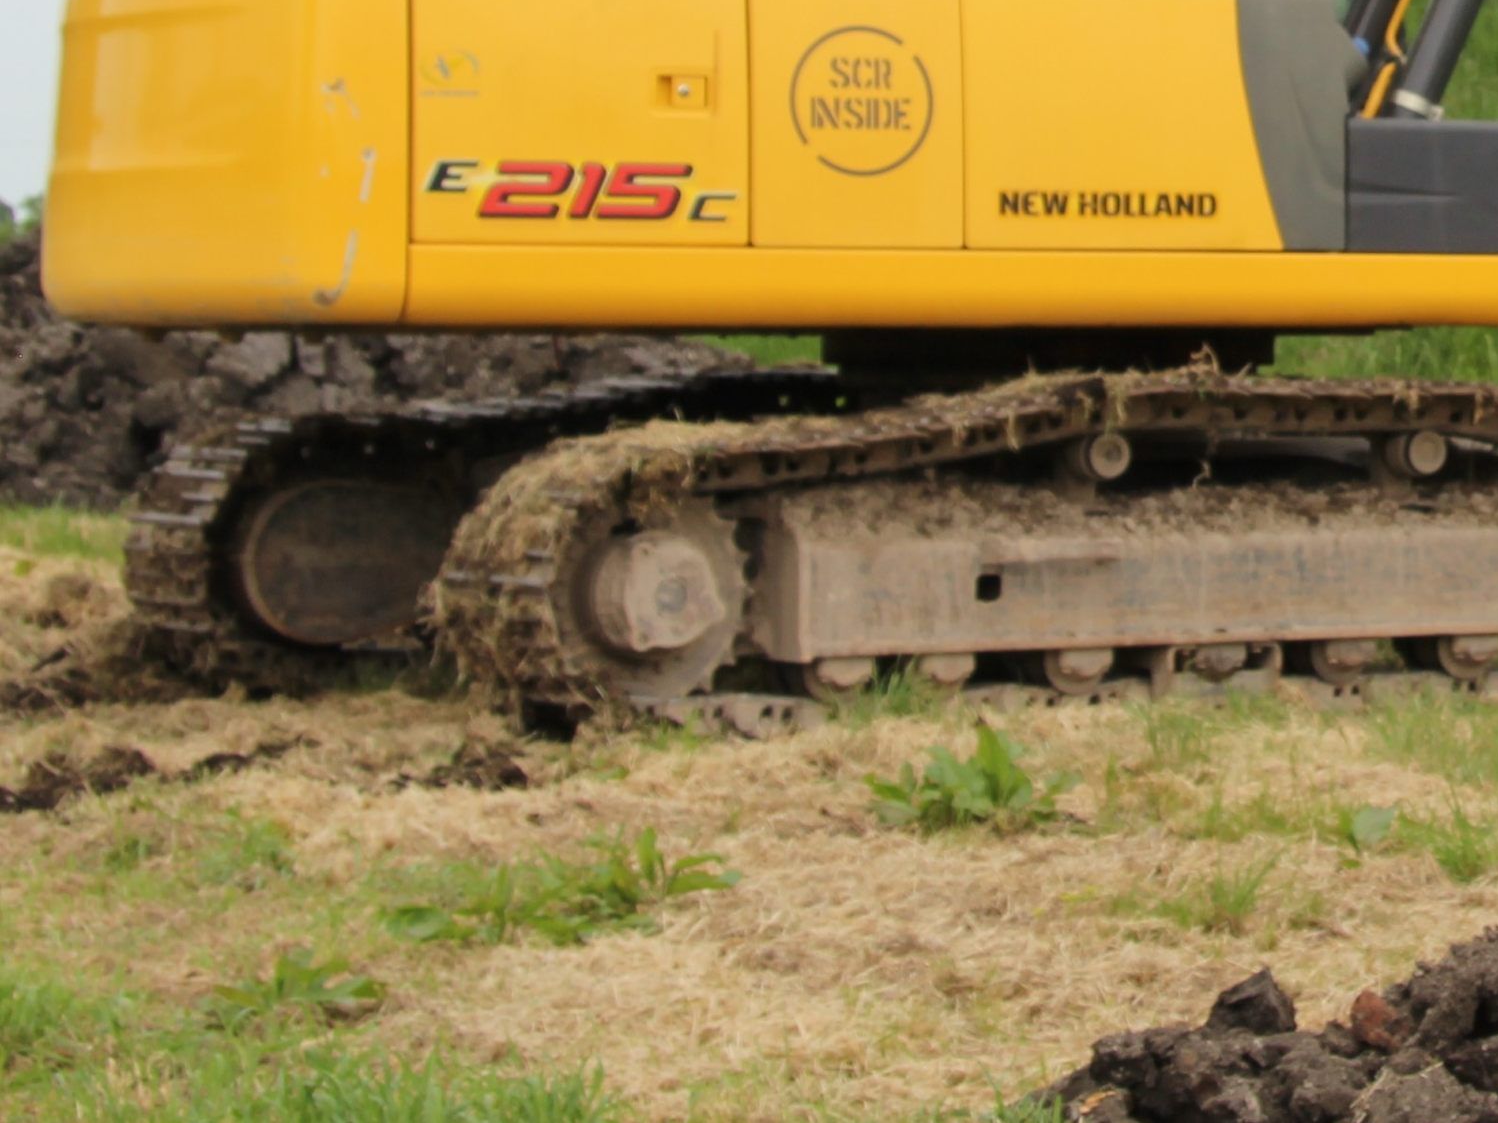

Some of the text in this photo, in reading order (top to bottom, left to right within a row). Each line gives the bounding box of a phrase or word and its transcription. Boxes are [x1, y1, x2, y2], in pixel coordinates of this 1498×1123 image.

[829, 57, 891, 90] SCR
[810, 97, 911, 130] INSIDE
[999, 191, 1217, 217] NEW HOLLAND
